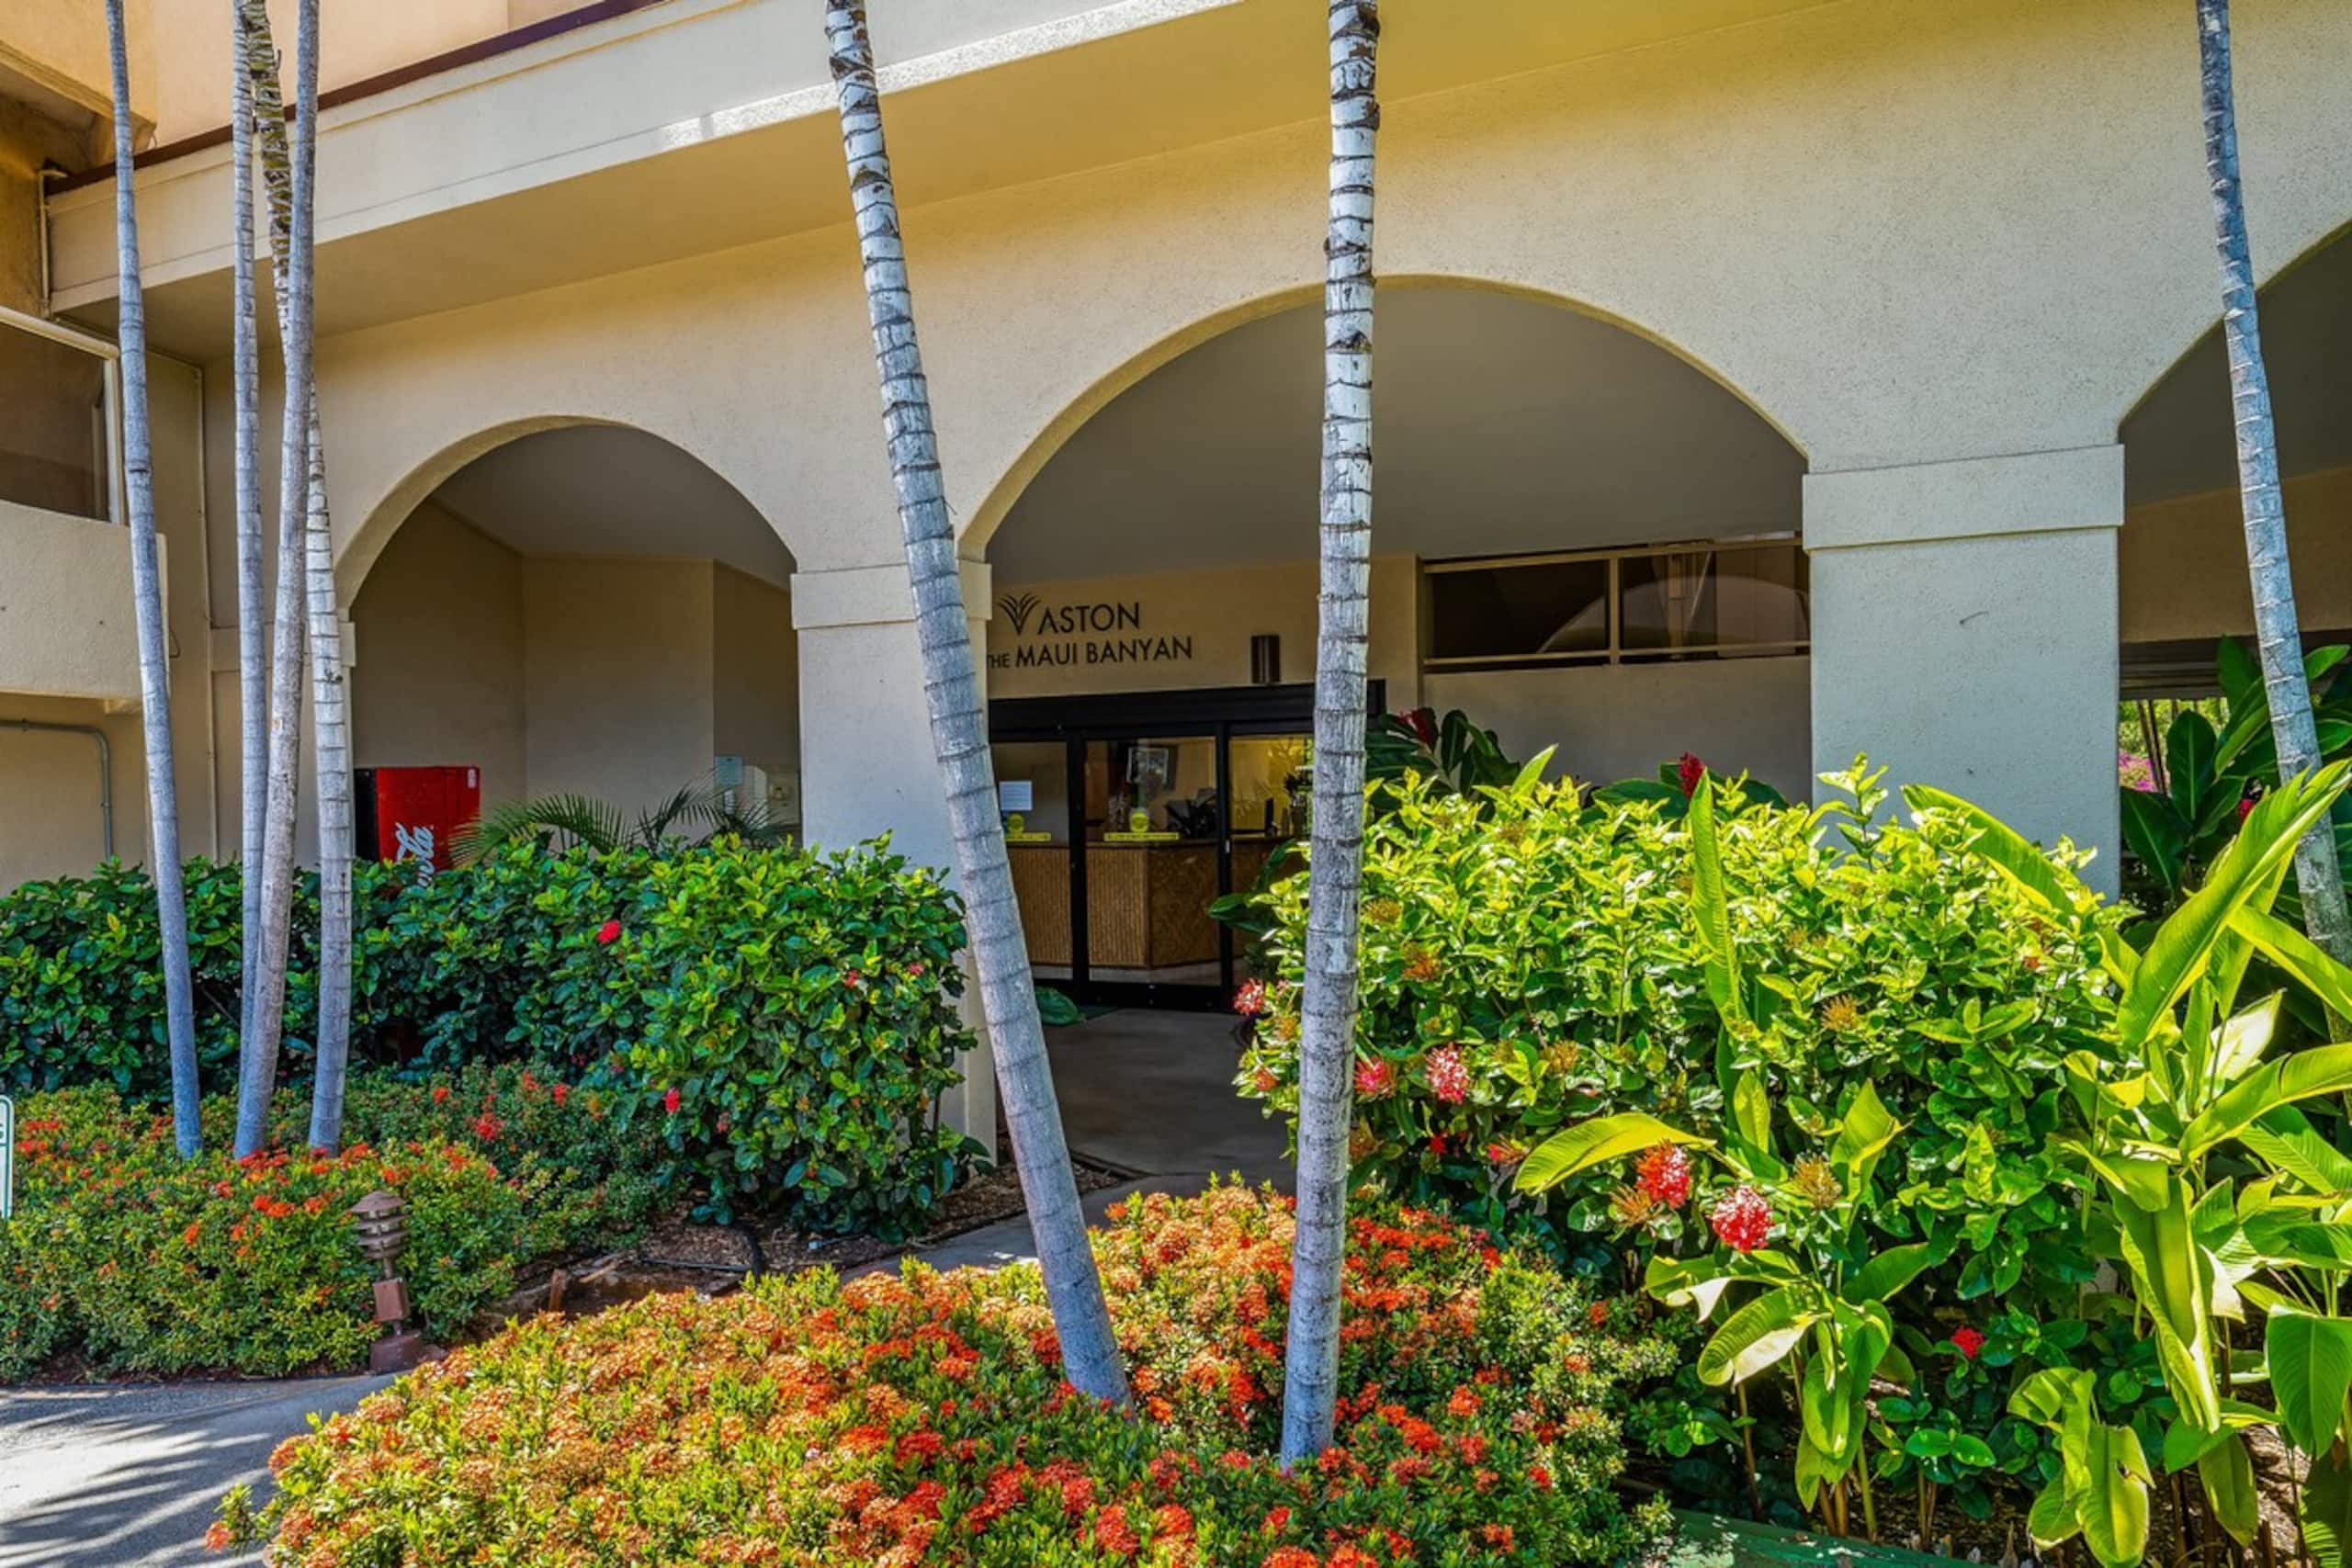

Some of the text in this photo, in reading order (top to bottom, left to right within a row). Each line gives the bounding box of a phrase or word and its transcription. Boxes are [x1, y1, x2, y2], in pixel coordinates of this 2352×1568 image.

[1036, 603, 1139, 636] ASTON
[1016, 642, 1077, 668] MAUI
[1087, 637, 1192, 663] BANYAN
